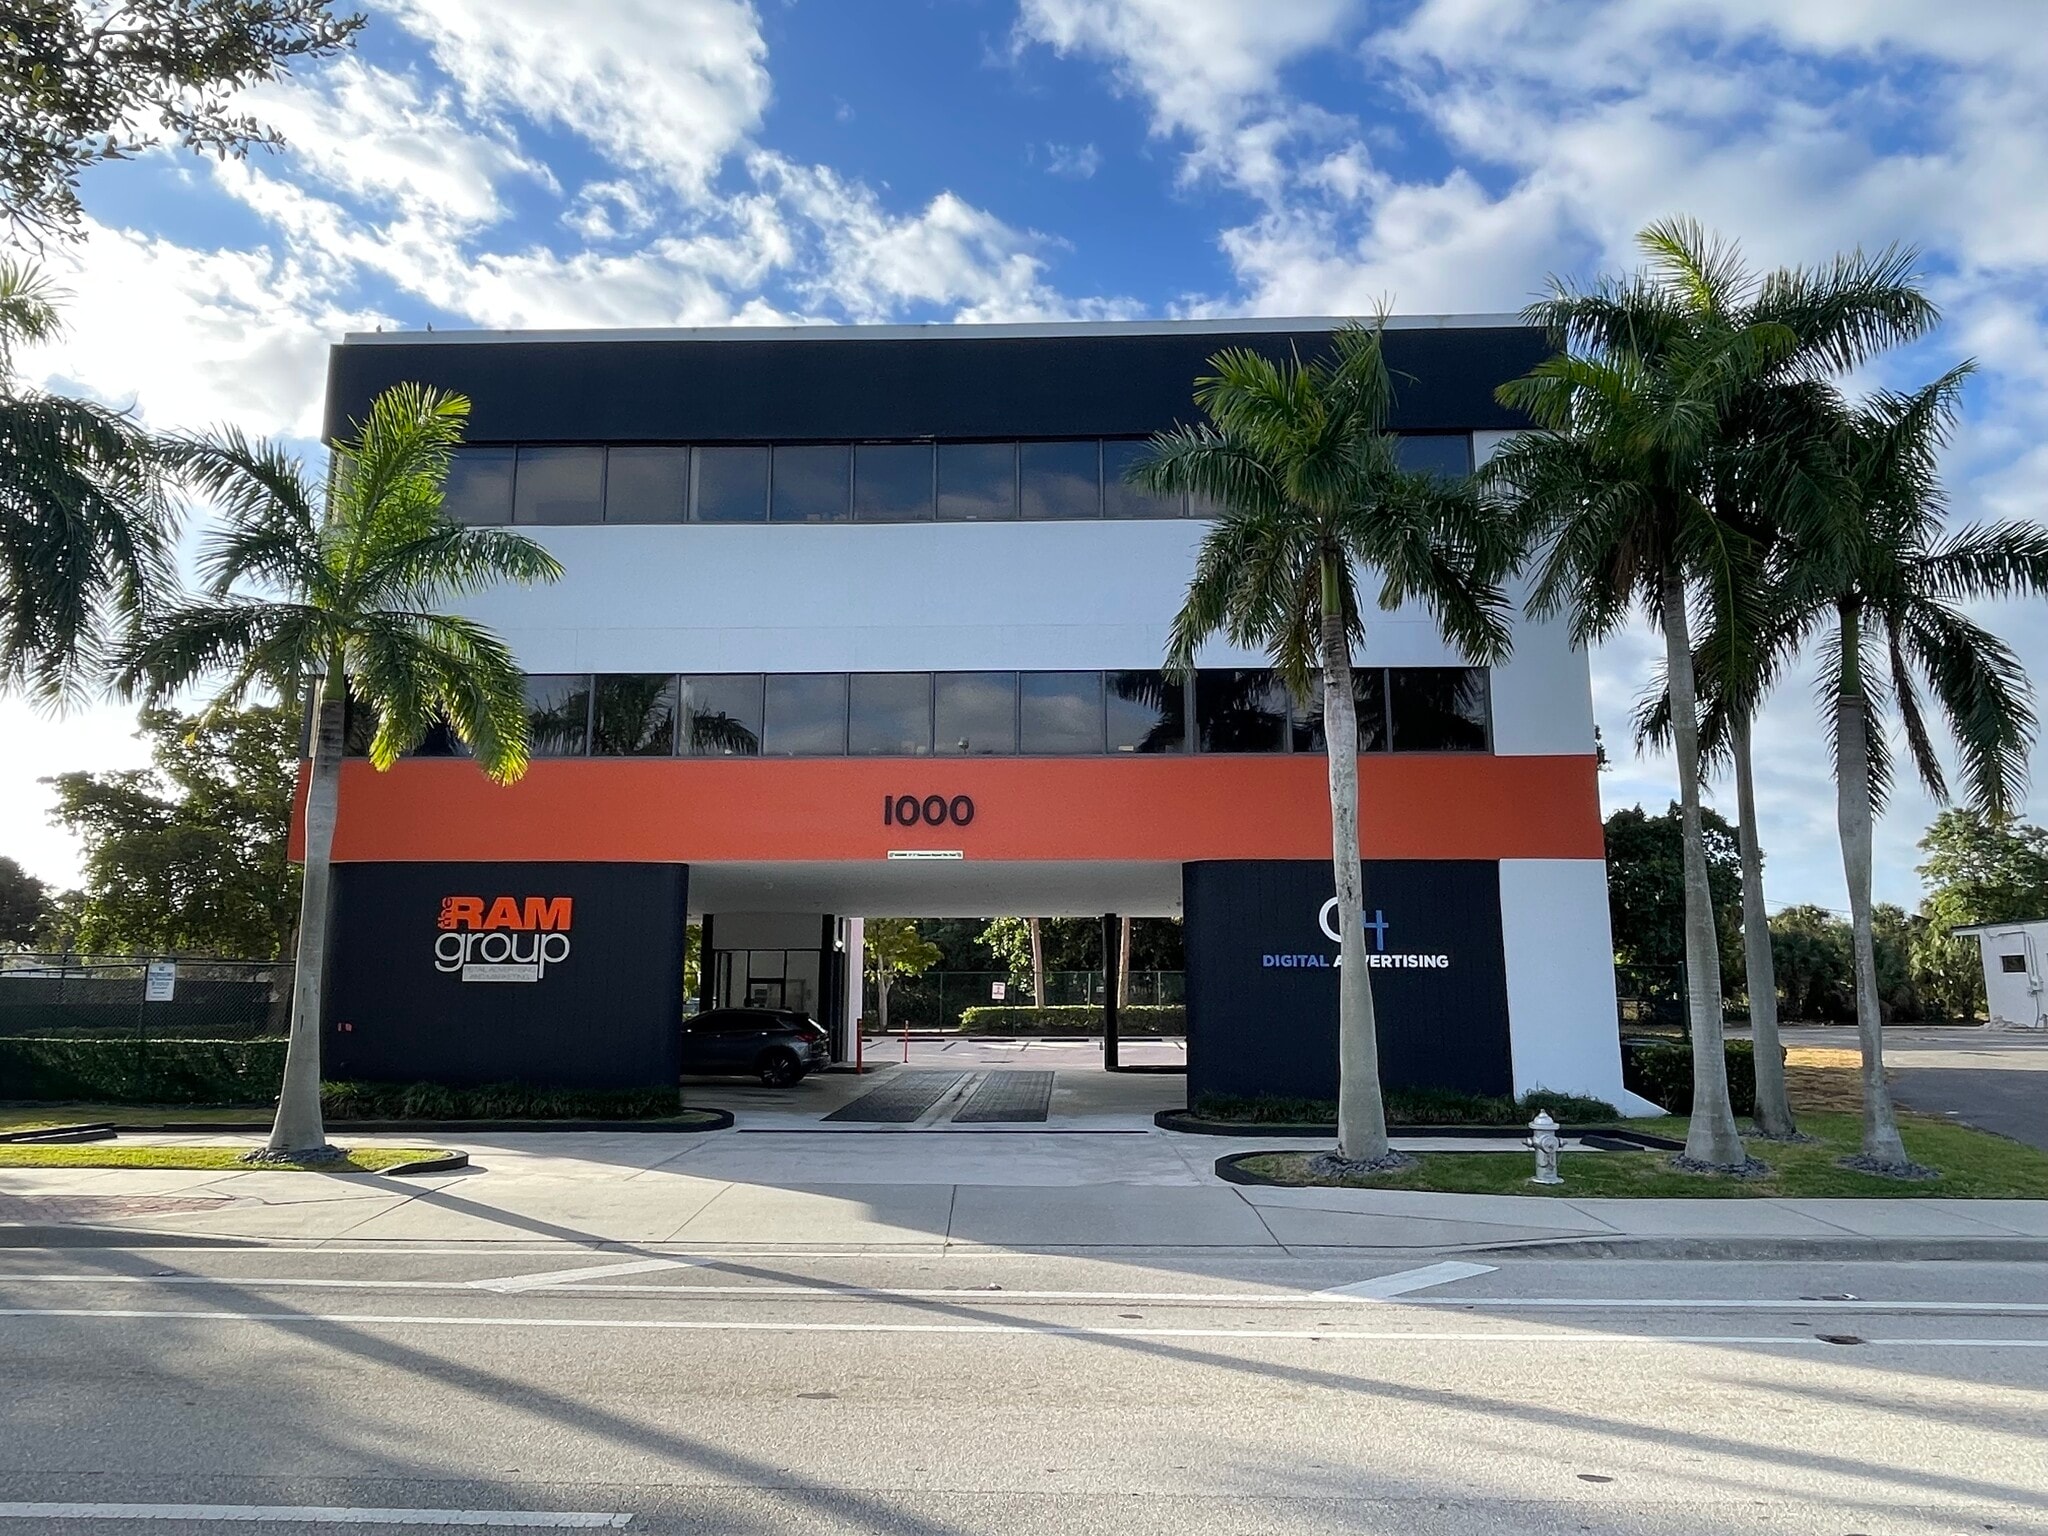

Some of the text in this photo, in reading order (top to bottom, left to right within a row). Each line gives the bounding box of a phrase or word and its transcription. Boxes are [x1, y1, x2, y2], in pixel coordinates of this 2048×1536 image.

[884, 795, 975, 826] 1000
[450, 896, 573, 930] RAM
[434, 932, 571, 979] group
[1262, 954, 1450, 969] DIGITAL AERTISING
